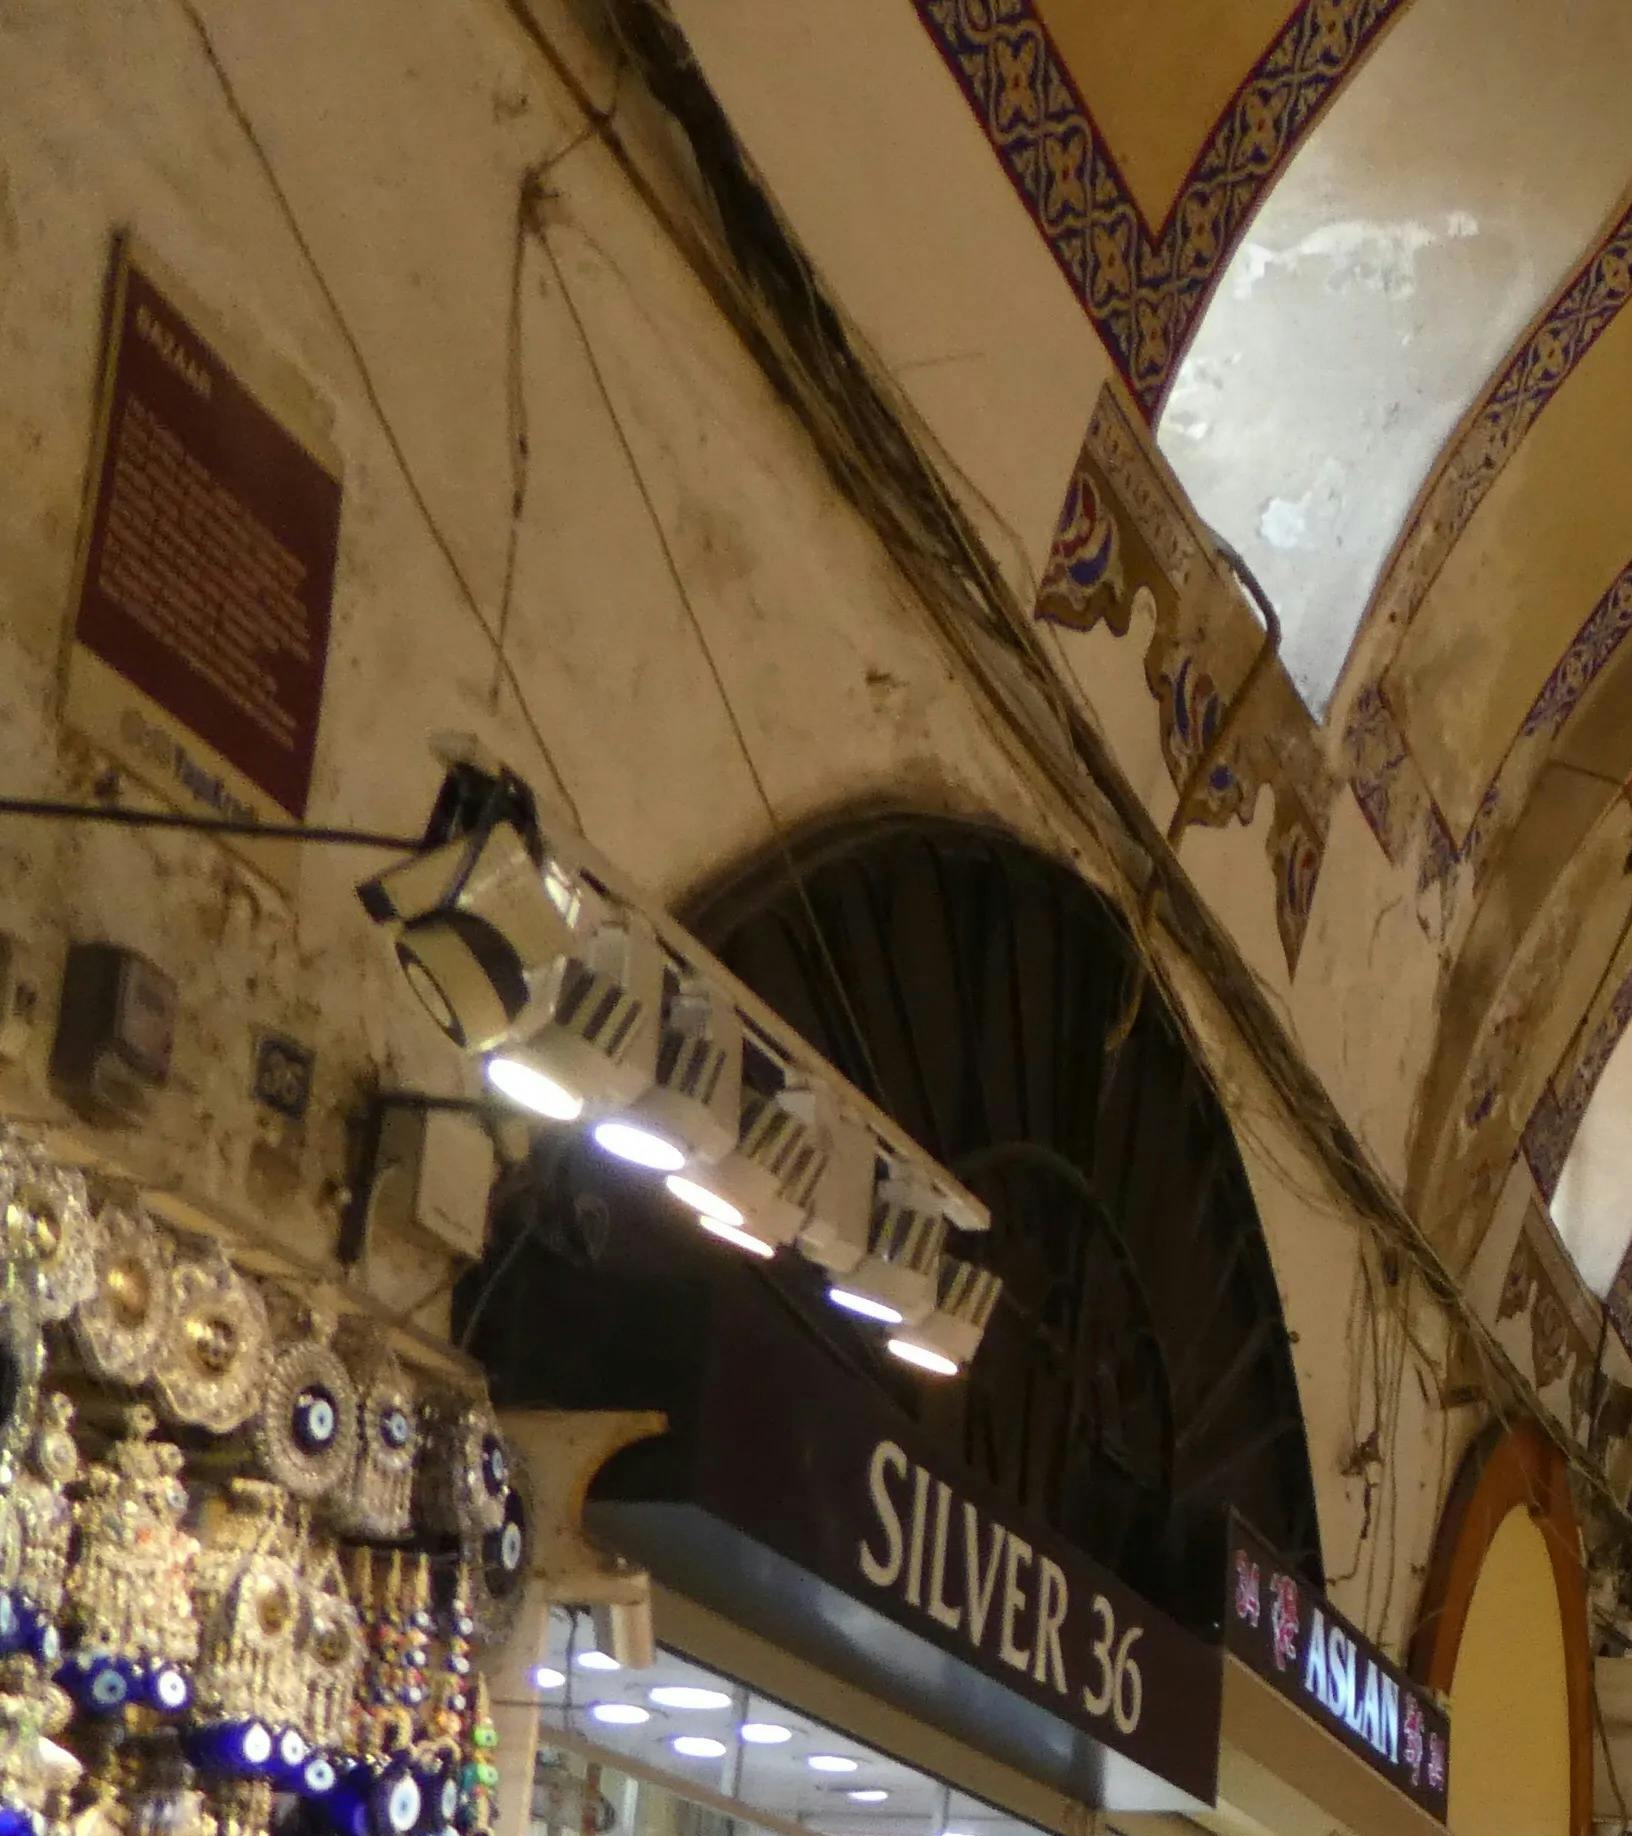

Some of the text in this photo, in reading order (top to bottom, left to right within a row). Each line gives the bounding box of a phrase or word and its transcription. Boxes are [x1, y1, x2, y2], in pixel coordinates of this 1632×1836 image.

[860, 1440, 1143, 1734] SILVER 36
[1304, 1607, 1400, 1764] ASLAN
